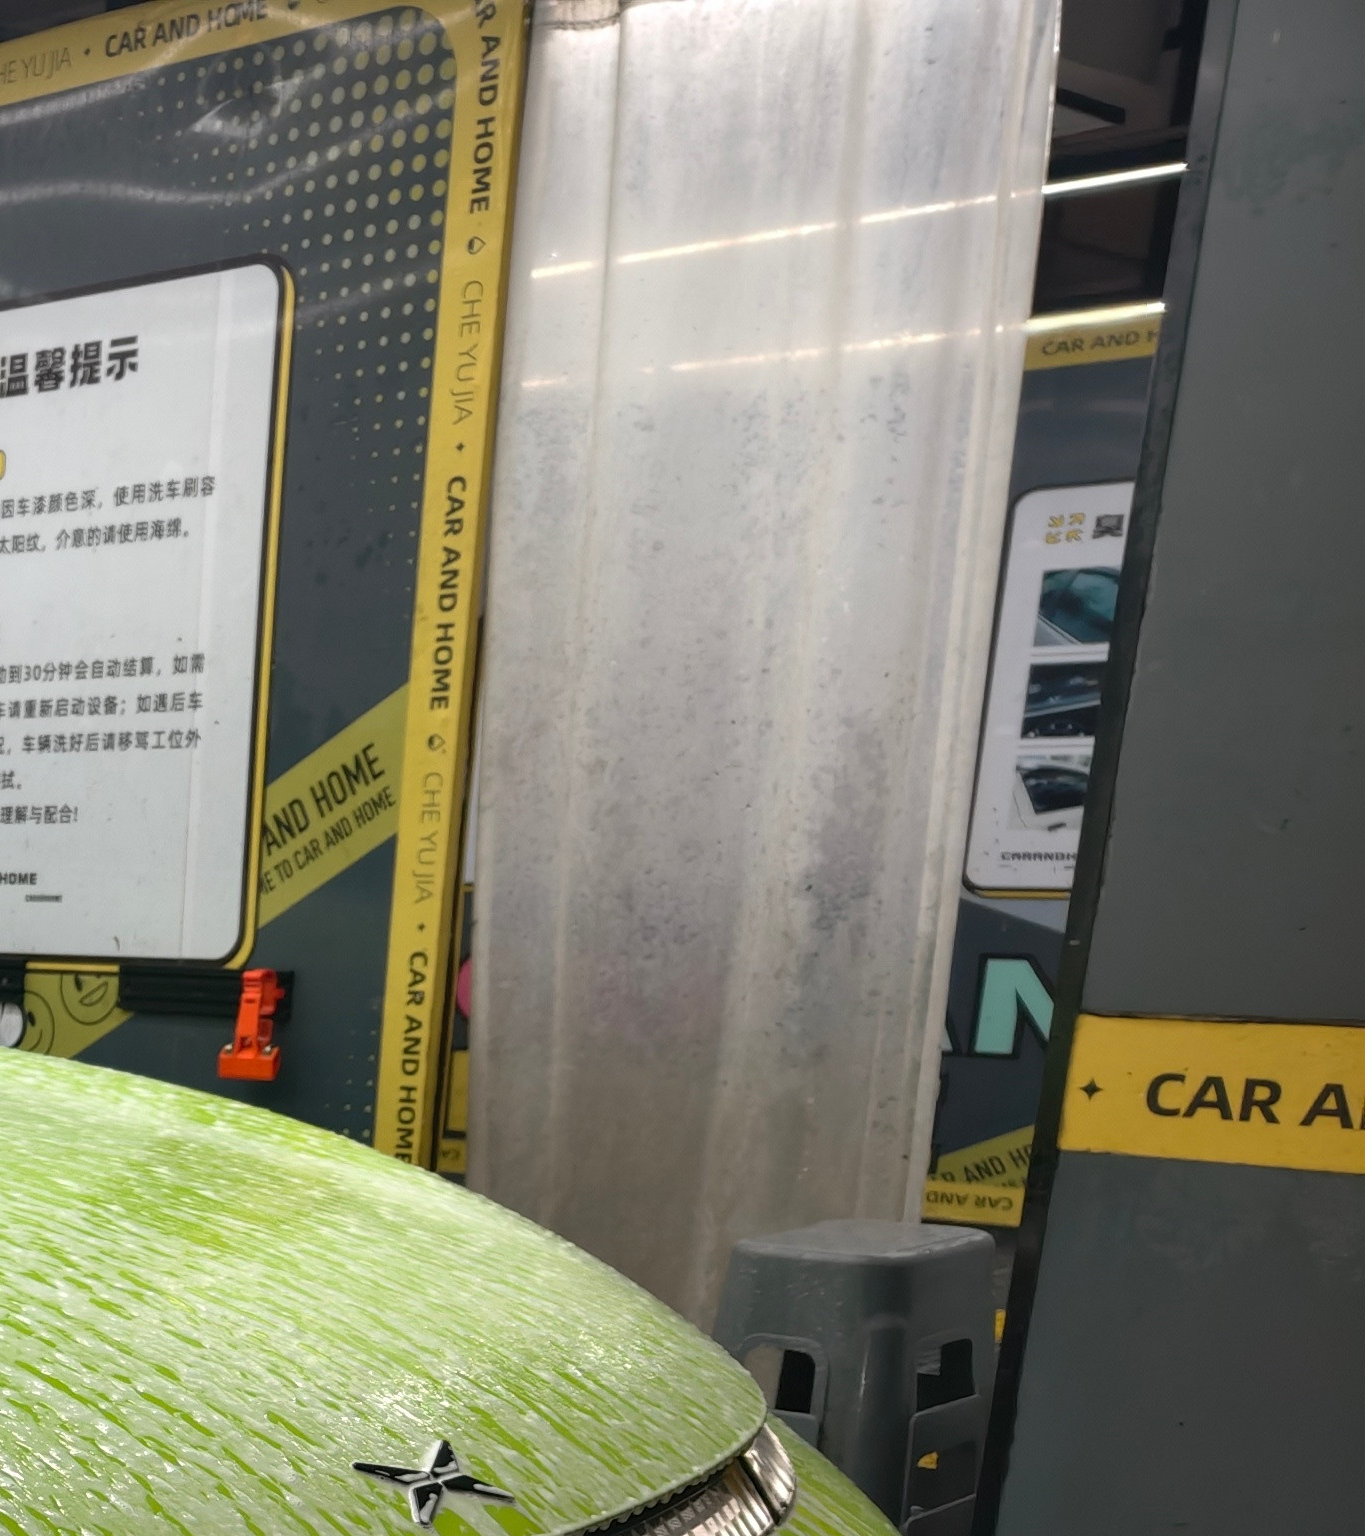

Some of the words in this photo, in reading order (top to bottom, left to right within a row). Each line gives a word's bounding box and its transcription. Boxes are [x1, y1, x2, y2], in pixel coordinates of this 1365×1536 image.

[105, 20, 150, 57] CAR
[153, 13, 200, 44] AND
[207, 0, 268, 33] HOME
[478, 35, 500, 107] AND
[469, 116, 496, 214] HOME
[459, 280, 483, 337] CHE
[0, 335, 139, 398] 温馨提示
[455, 344, 478, 382] YU
[1042, 338, 1085, 355] CAR
[1091, 331, 1140, 349] AND
[450, 390, 474, 424] JIA
[445, 476, 466, 537] CAR
[438, 546, 461, 612] AND
[430, 622, 455, 710] HOME
[261, 798, 310, 856] AND
[310, 743, 385, 818] HOME
[421, 772, 443, 823] CHE
[274, 859, 293, 883] TO
[294, 838, 324, 870] CAR
[325, 817, 352, 850] AND
[352, 786, 396, 828] HOME
[417, 831, 439, 864] YU
[413, 871, 434, 904] JIA
[408, 950, 428, 1008] CAR
[401, 1014, 420, 1076] AND
[393, 1084, 416, 1164] HOME
[1146, 1073, 1281, 1125] CAR
[1299, 1083, 1365, 1130] A
[964, 1154, 1006, 1184] AND
